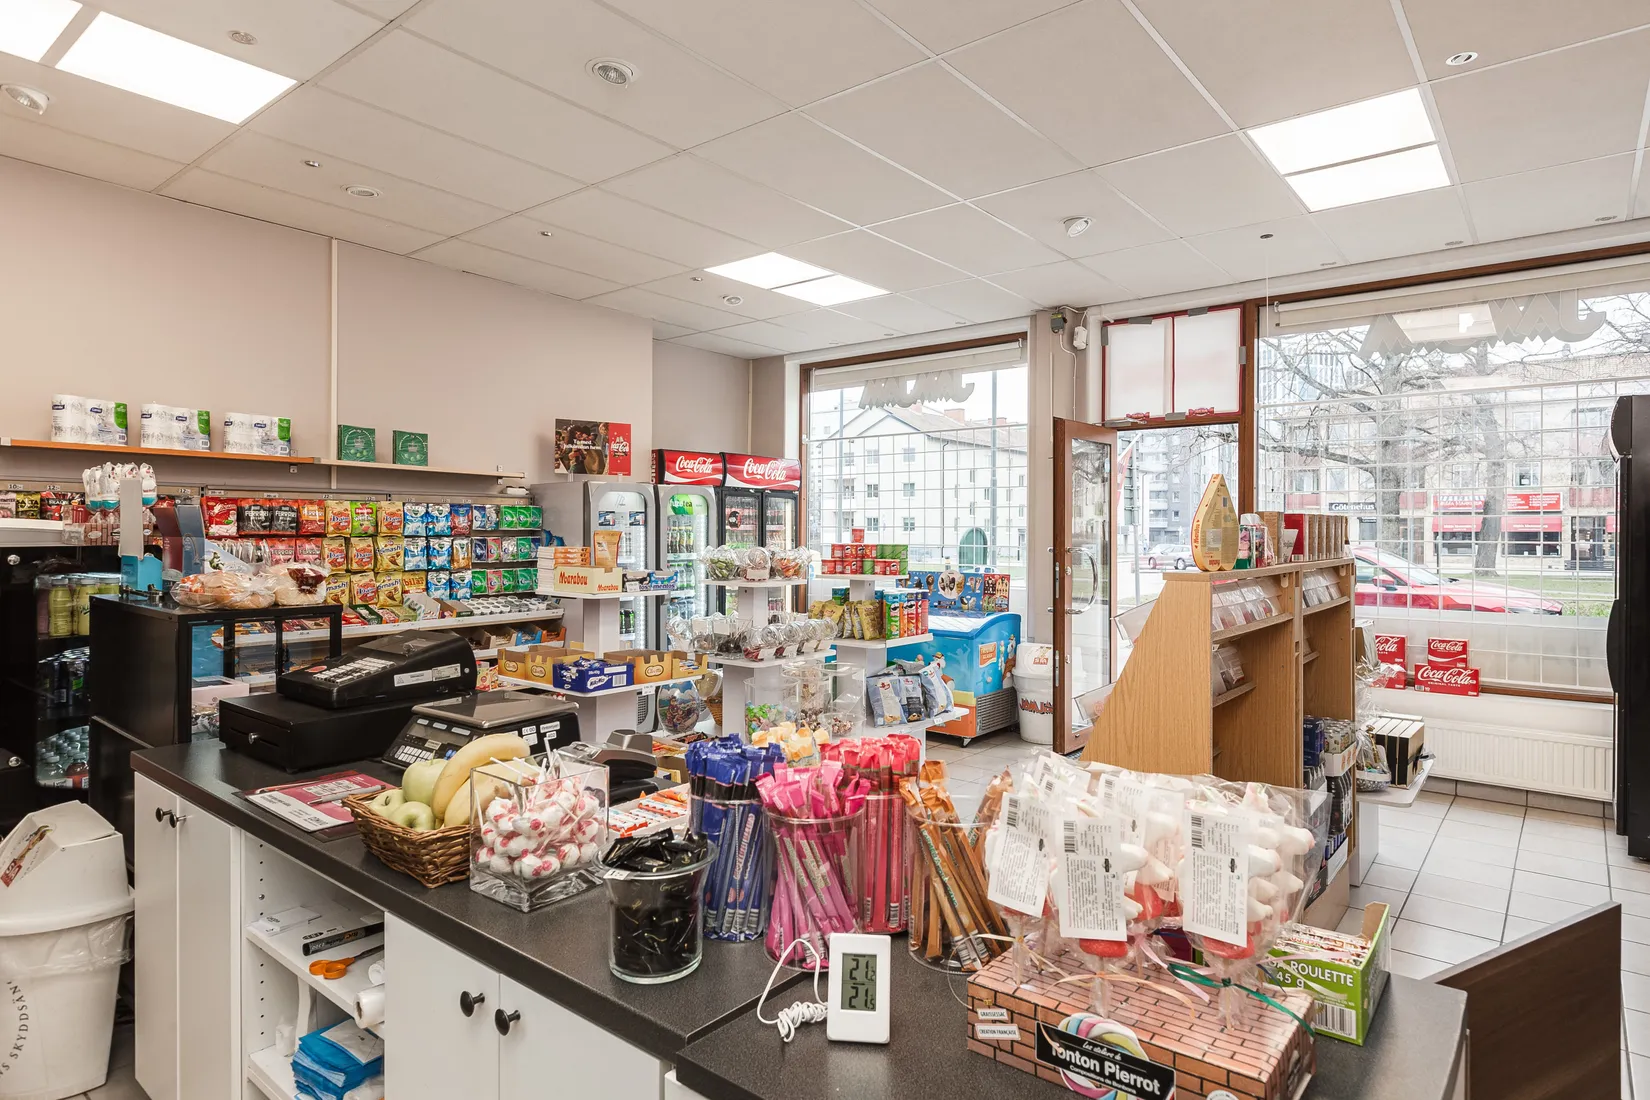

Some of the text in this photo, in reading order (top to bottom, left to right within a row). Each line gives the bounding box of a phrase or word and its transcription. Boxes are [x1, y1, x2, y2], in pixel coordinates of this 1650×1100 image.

[675, 455, 714, 474] Coca-Cola
[743, 458, 787, 481] Coca-Cola
[326, 581, 348, 592] mash!
[558, 571, 588, 586] Marabou
[1430, 640, 1464, 652] Coca-Cola
[1417, 665, 1475, 685] Coca-Cola
[1290, 961, 1354, 987] ROULETTE
[1051, 1045, 1161, 1095] Tonton Pierrot
[1112, 1079, 1137, 1095] Bonbons
